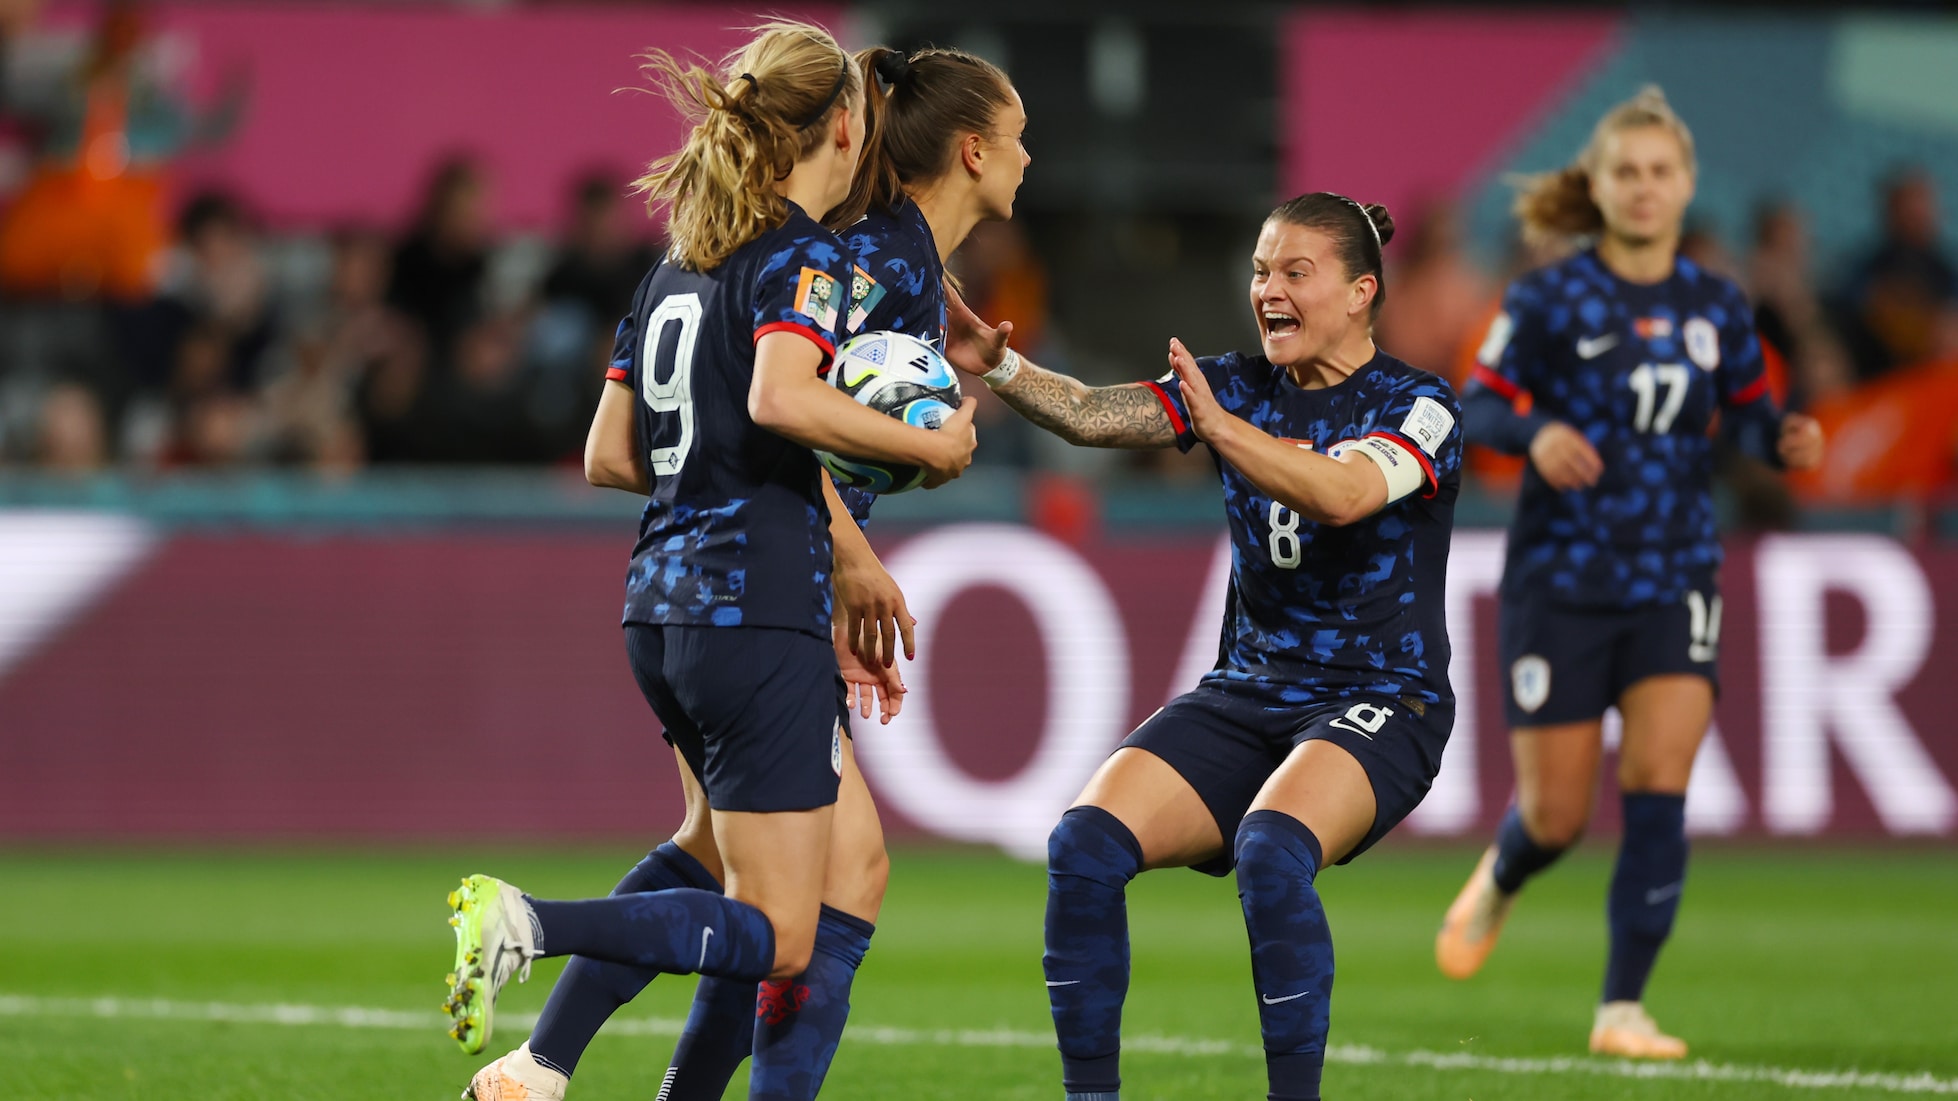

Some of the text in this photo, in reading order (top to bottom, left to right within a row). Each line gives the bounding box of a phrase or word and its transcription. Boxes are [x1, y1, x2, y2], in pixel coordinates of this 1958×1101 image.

[642, 292, 703, 476] 9
[1629, 364, 1689, 435] 17
[1366, 441, 1399, 468] INCLUSION
[1422, 409, 1445, 432] UNITES
[1268, 500, 1301, 569] 8
[853, 521, 1957, 863] QTR
